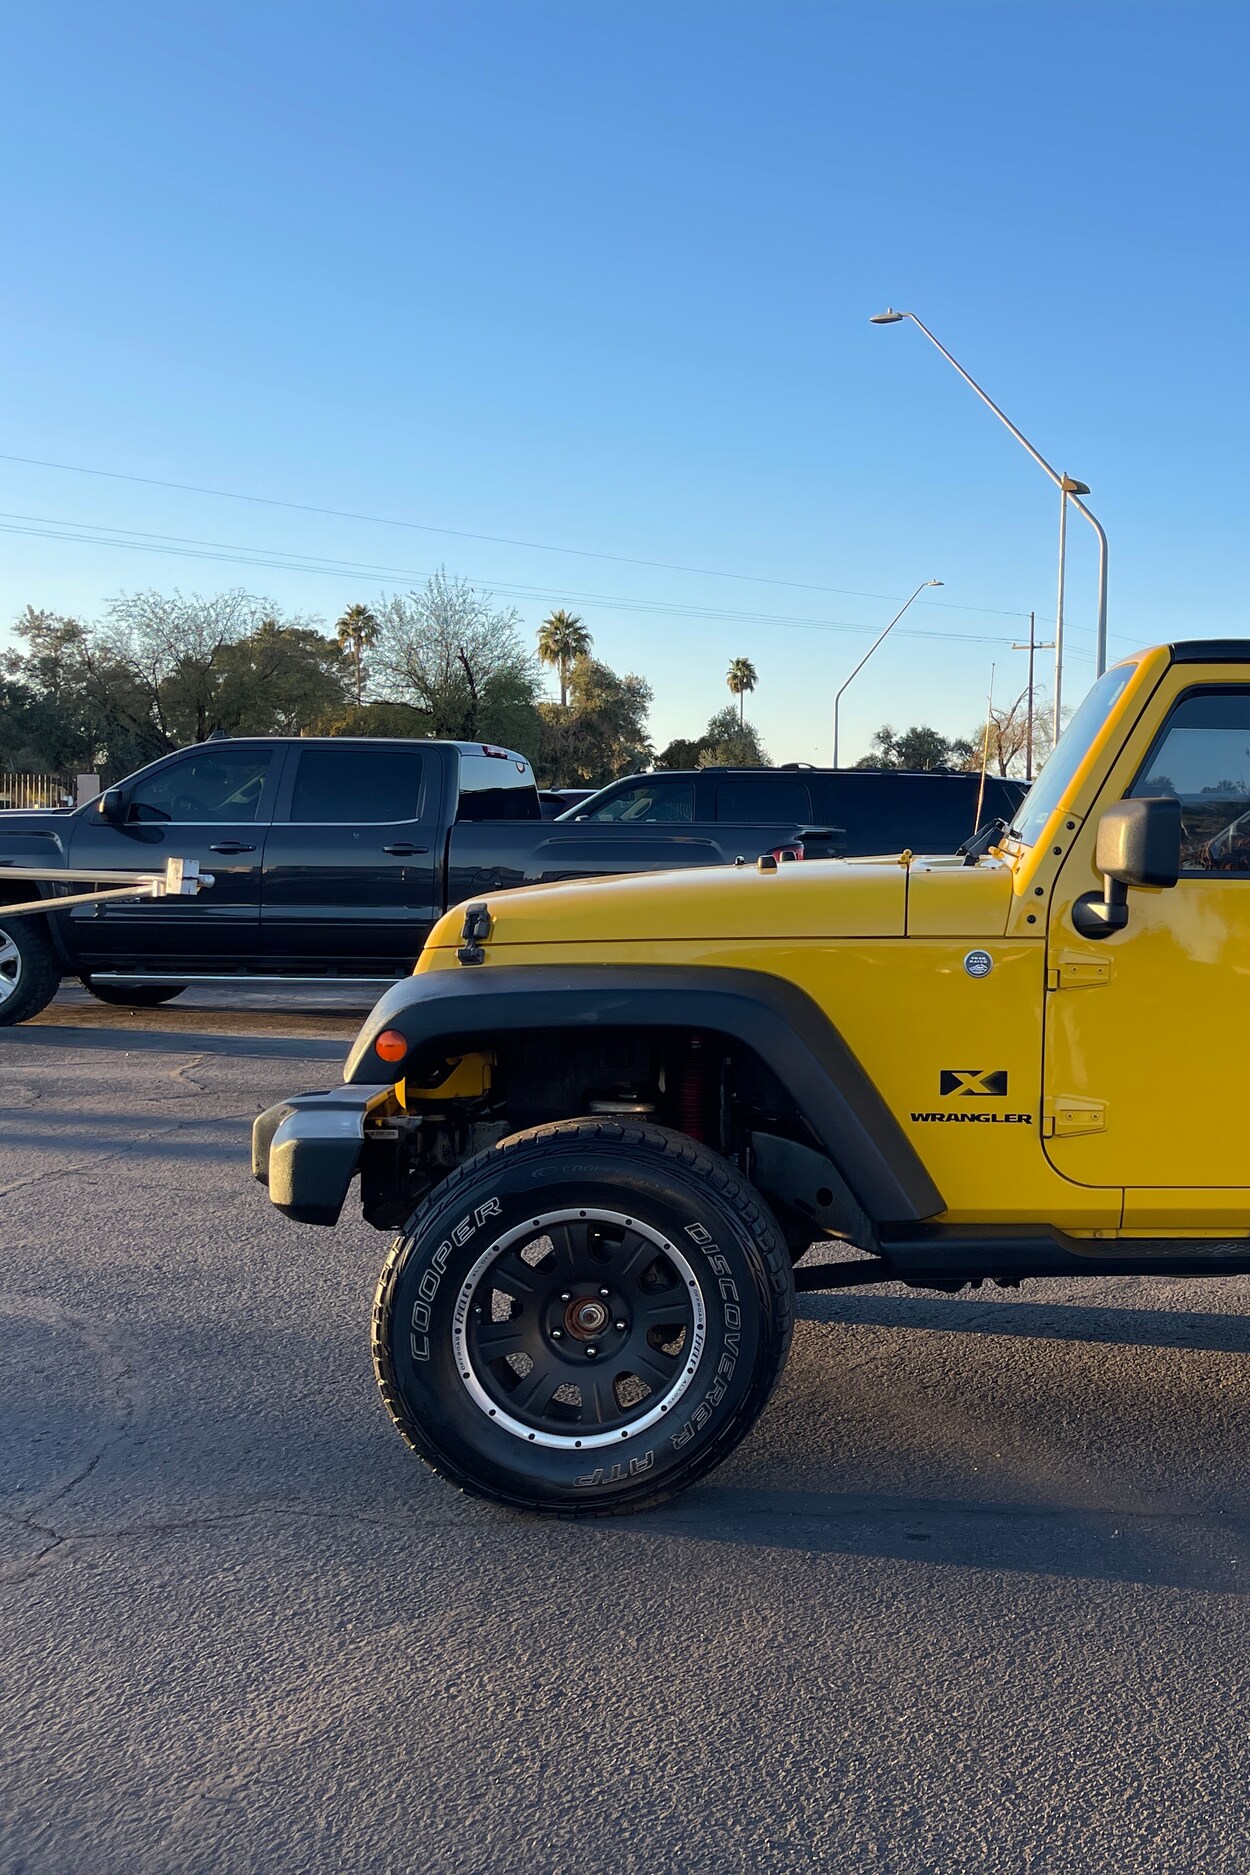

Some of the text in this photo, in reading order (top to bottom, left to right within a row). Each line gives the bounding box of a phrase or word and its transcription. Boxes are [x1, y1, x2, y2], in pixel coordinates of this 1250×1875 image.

[910, 1112, 1033, 1125] WRANGLER
[409, 1196, 744, 1488] COOPER DISCOVERER ATP
